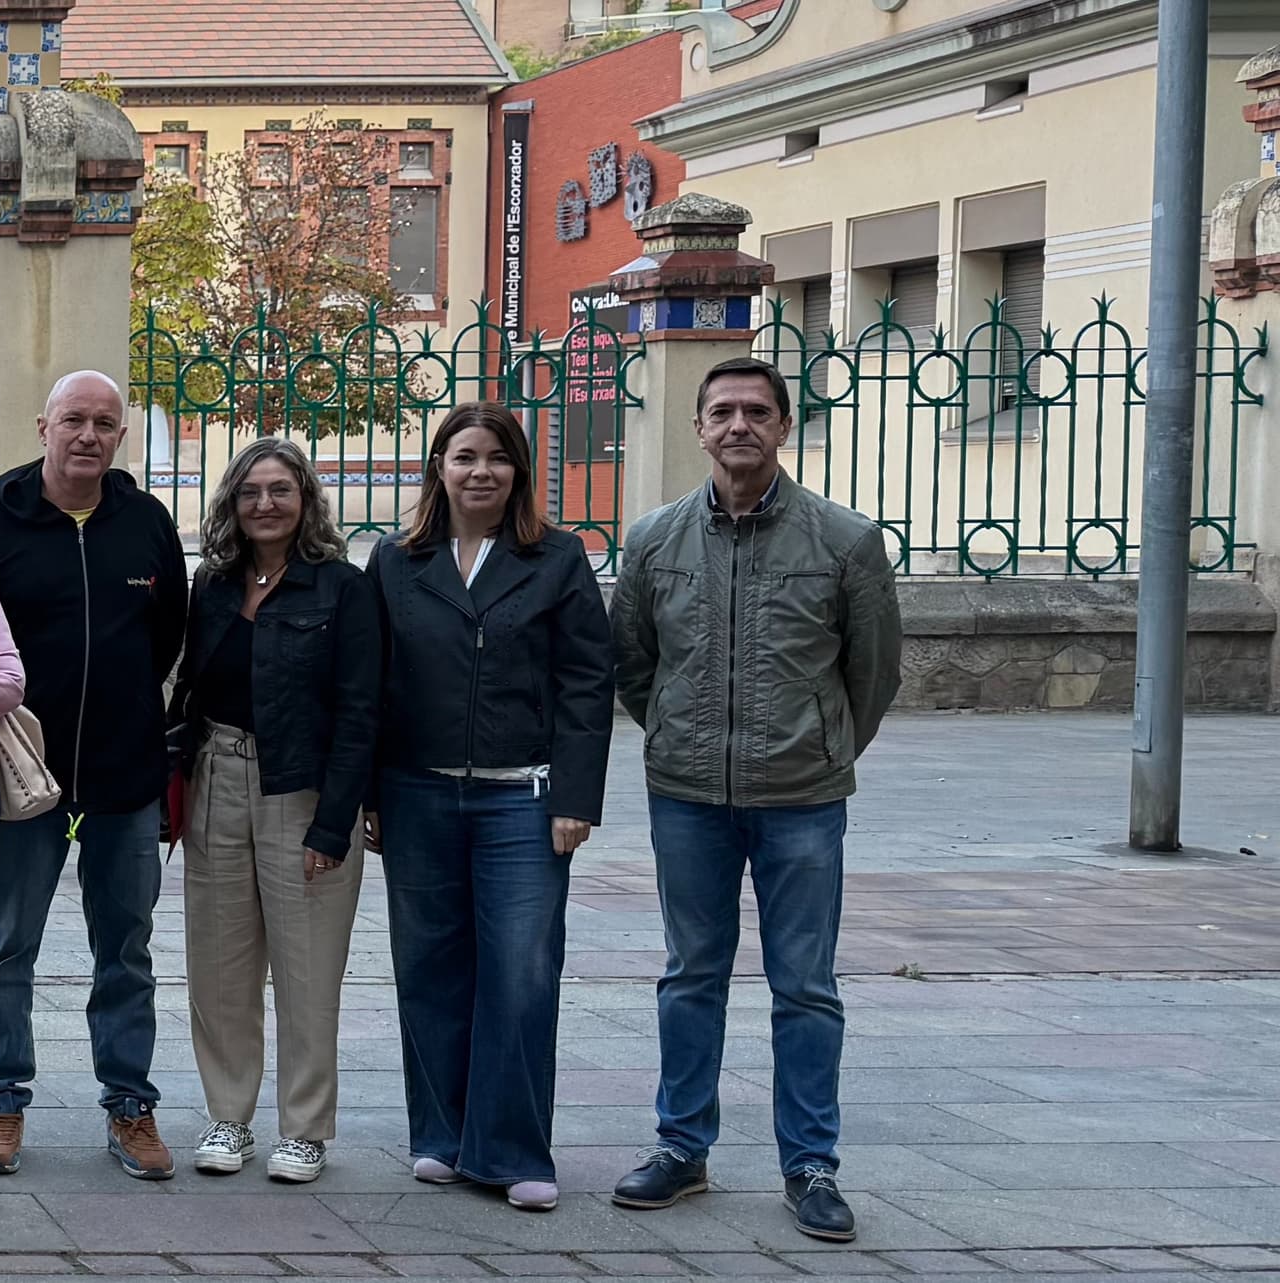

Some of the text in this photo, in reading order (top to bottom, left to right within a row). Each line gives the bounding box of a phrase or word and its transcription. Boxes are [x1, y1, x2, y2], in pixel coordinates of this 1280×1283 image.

[506, 139, 523, 233] l'Escorxador
[506, 235, 520, 254] de
[504, 255, 522, 327] Municipal
[571, 352, 598, 367] Teate
